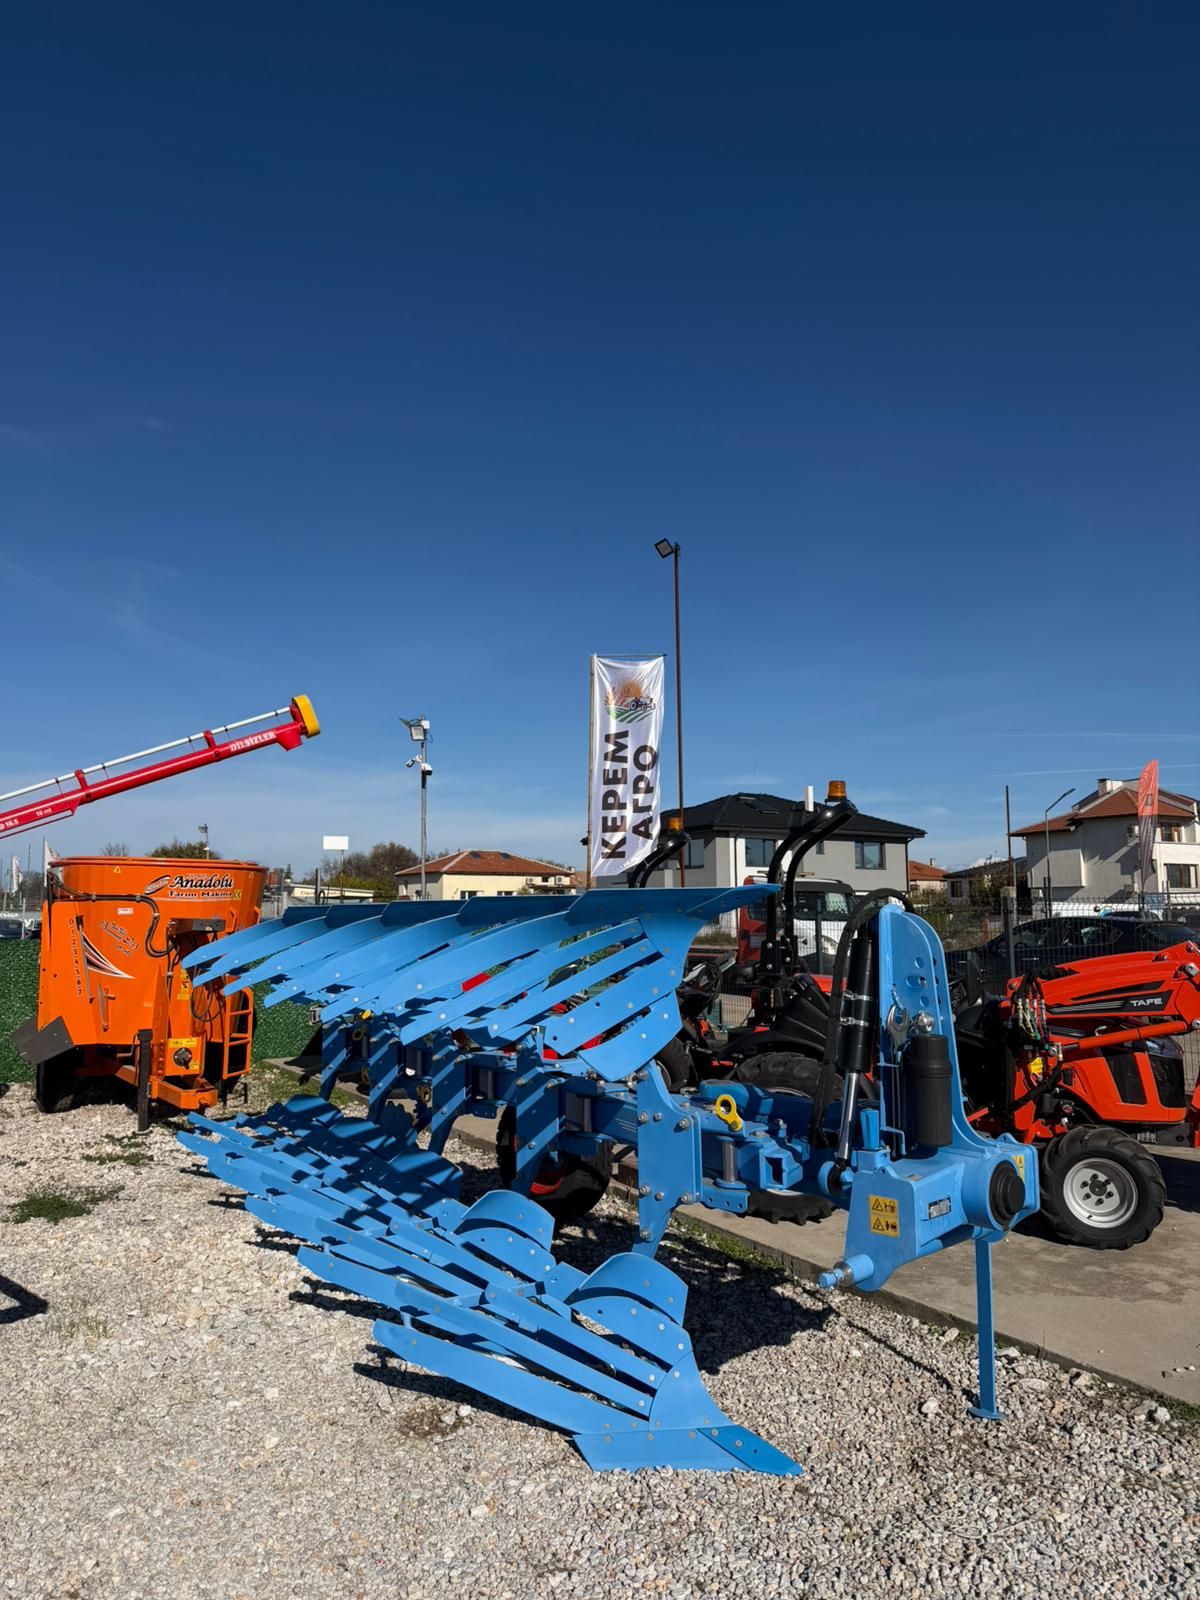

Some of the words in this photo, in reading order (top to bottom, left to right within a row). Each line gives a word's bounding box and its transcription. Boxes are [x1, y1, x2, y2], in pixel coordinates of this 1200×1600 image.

[601, 729, 630, 860] КЕРЕМ
[632, 743, 658, 841] АГРО
[169, 873, 234, 889] Anadolu
[1129, 997, 1163, 1007] TAFE
